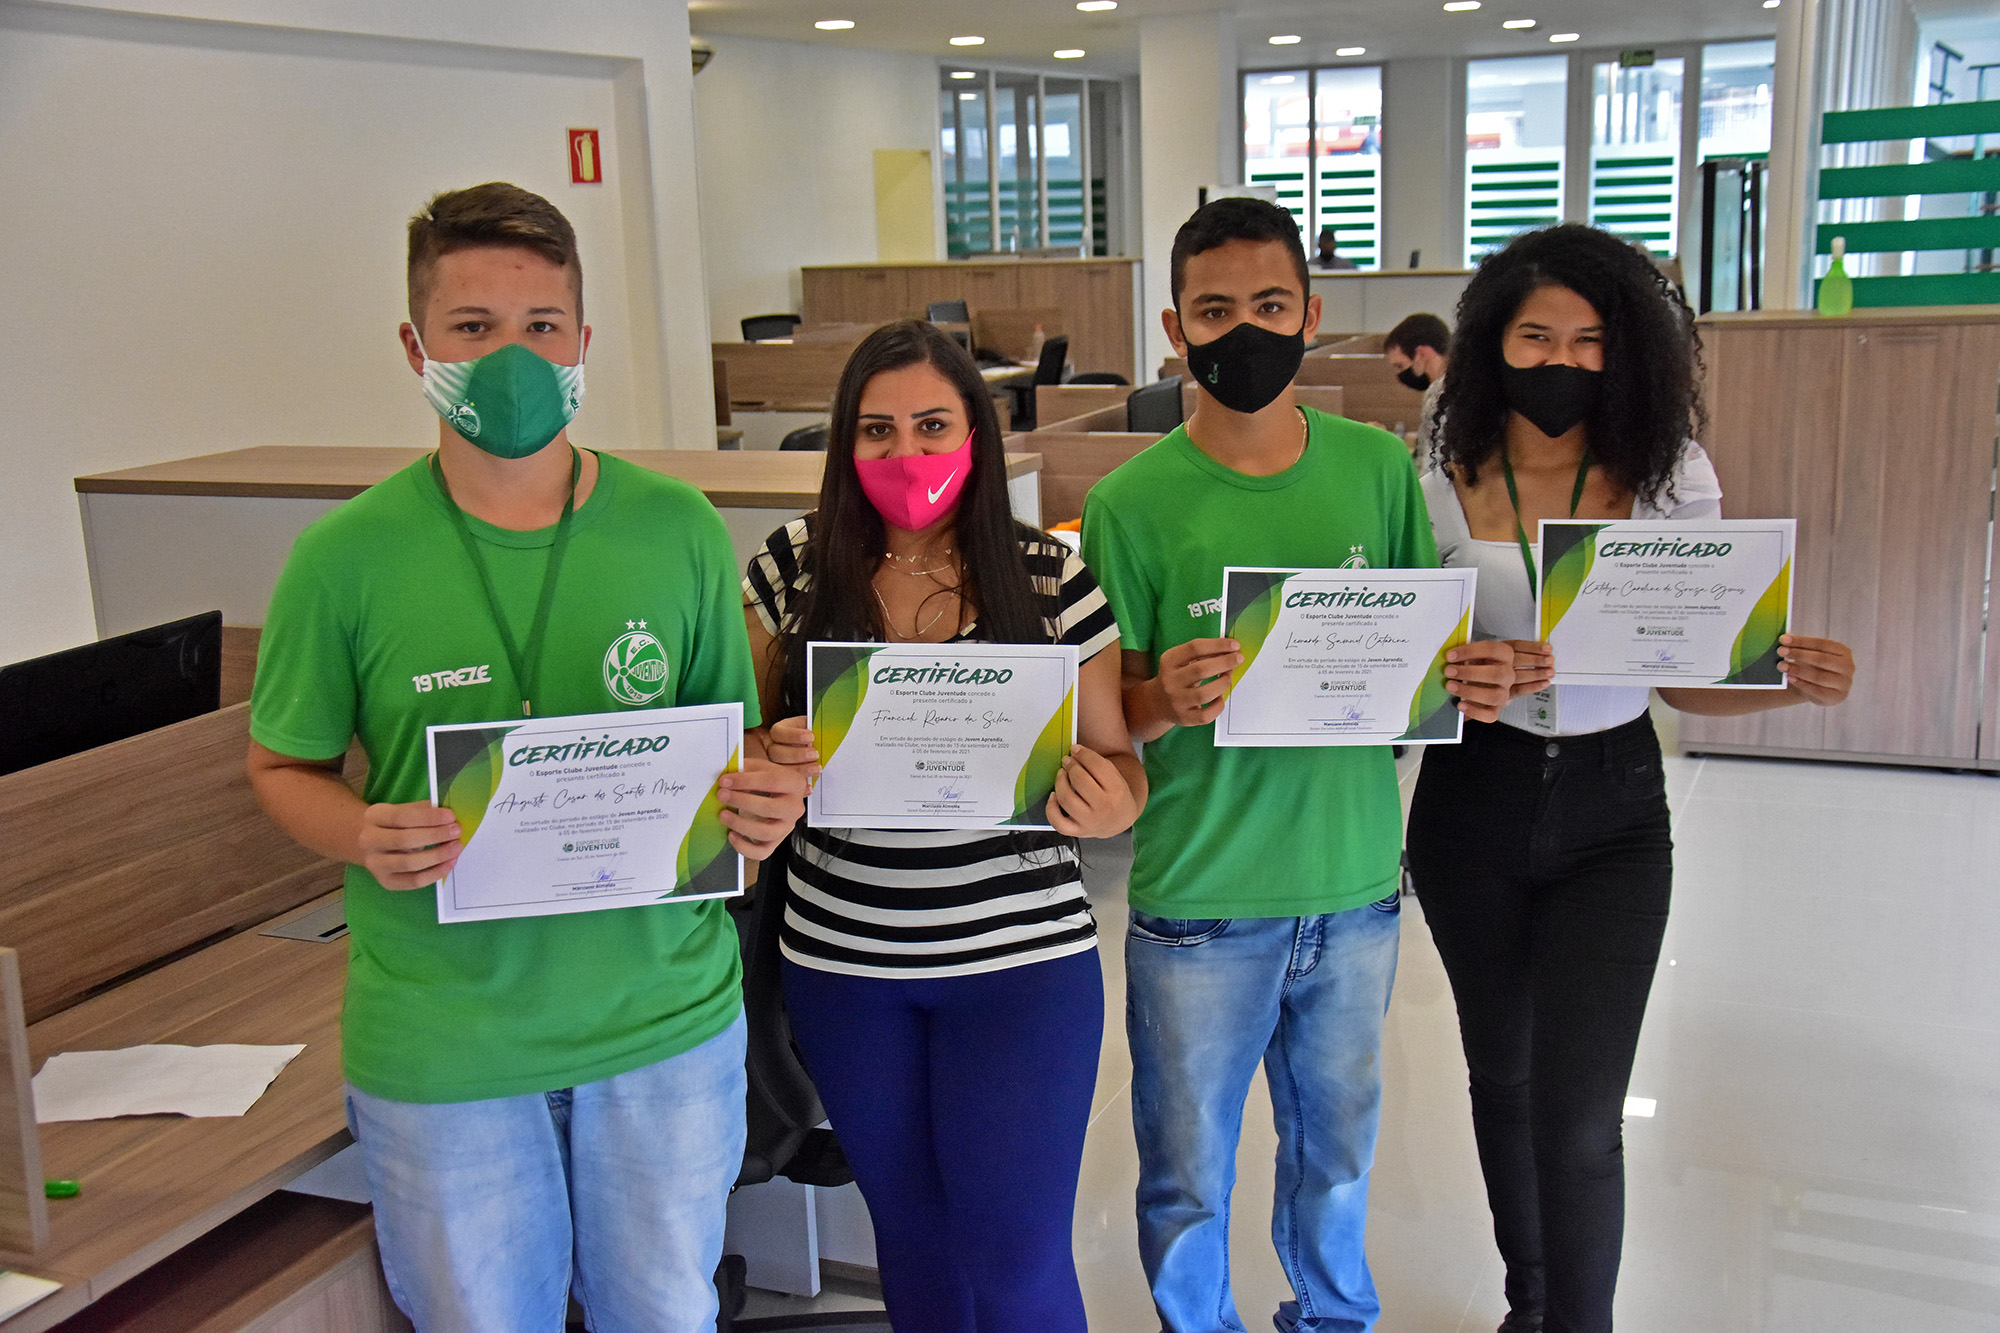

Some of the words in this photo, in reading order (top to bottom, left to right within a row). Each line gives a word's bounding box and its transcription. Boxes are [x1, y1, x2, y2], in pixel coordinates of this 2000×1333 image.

[1599, 537, 1733, 558] CERTIFICADO
[1285, 586, 1417, 609] CERTIFICADO
[873, 661, 1014, 686] CERTIFICADO
[627, 685, 643, 700] 1913
[982, 710, 1013, 729] Silva
[508, 733, 671, 768] CERTIFICADO
[536, 769, 562, 777] Esporte
[584, 764, 618, 772] Juventude
[613, 782, 646, 804] Santos
[574, 842, 620, 852] JUVENTUDE
